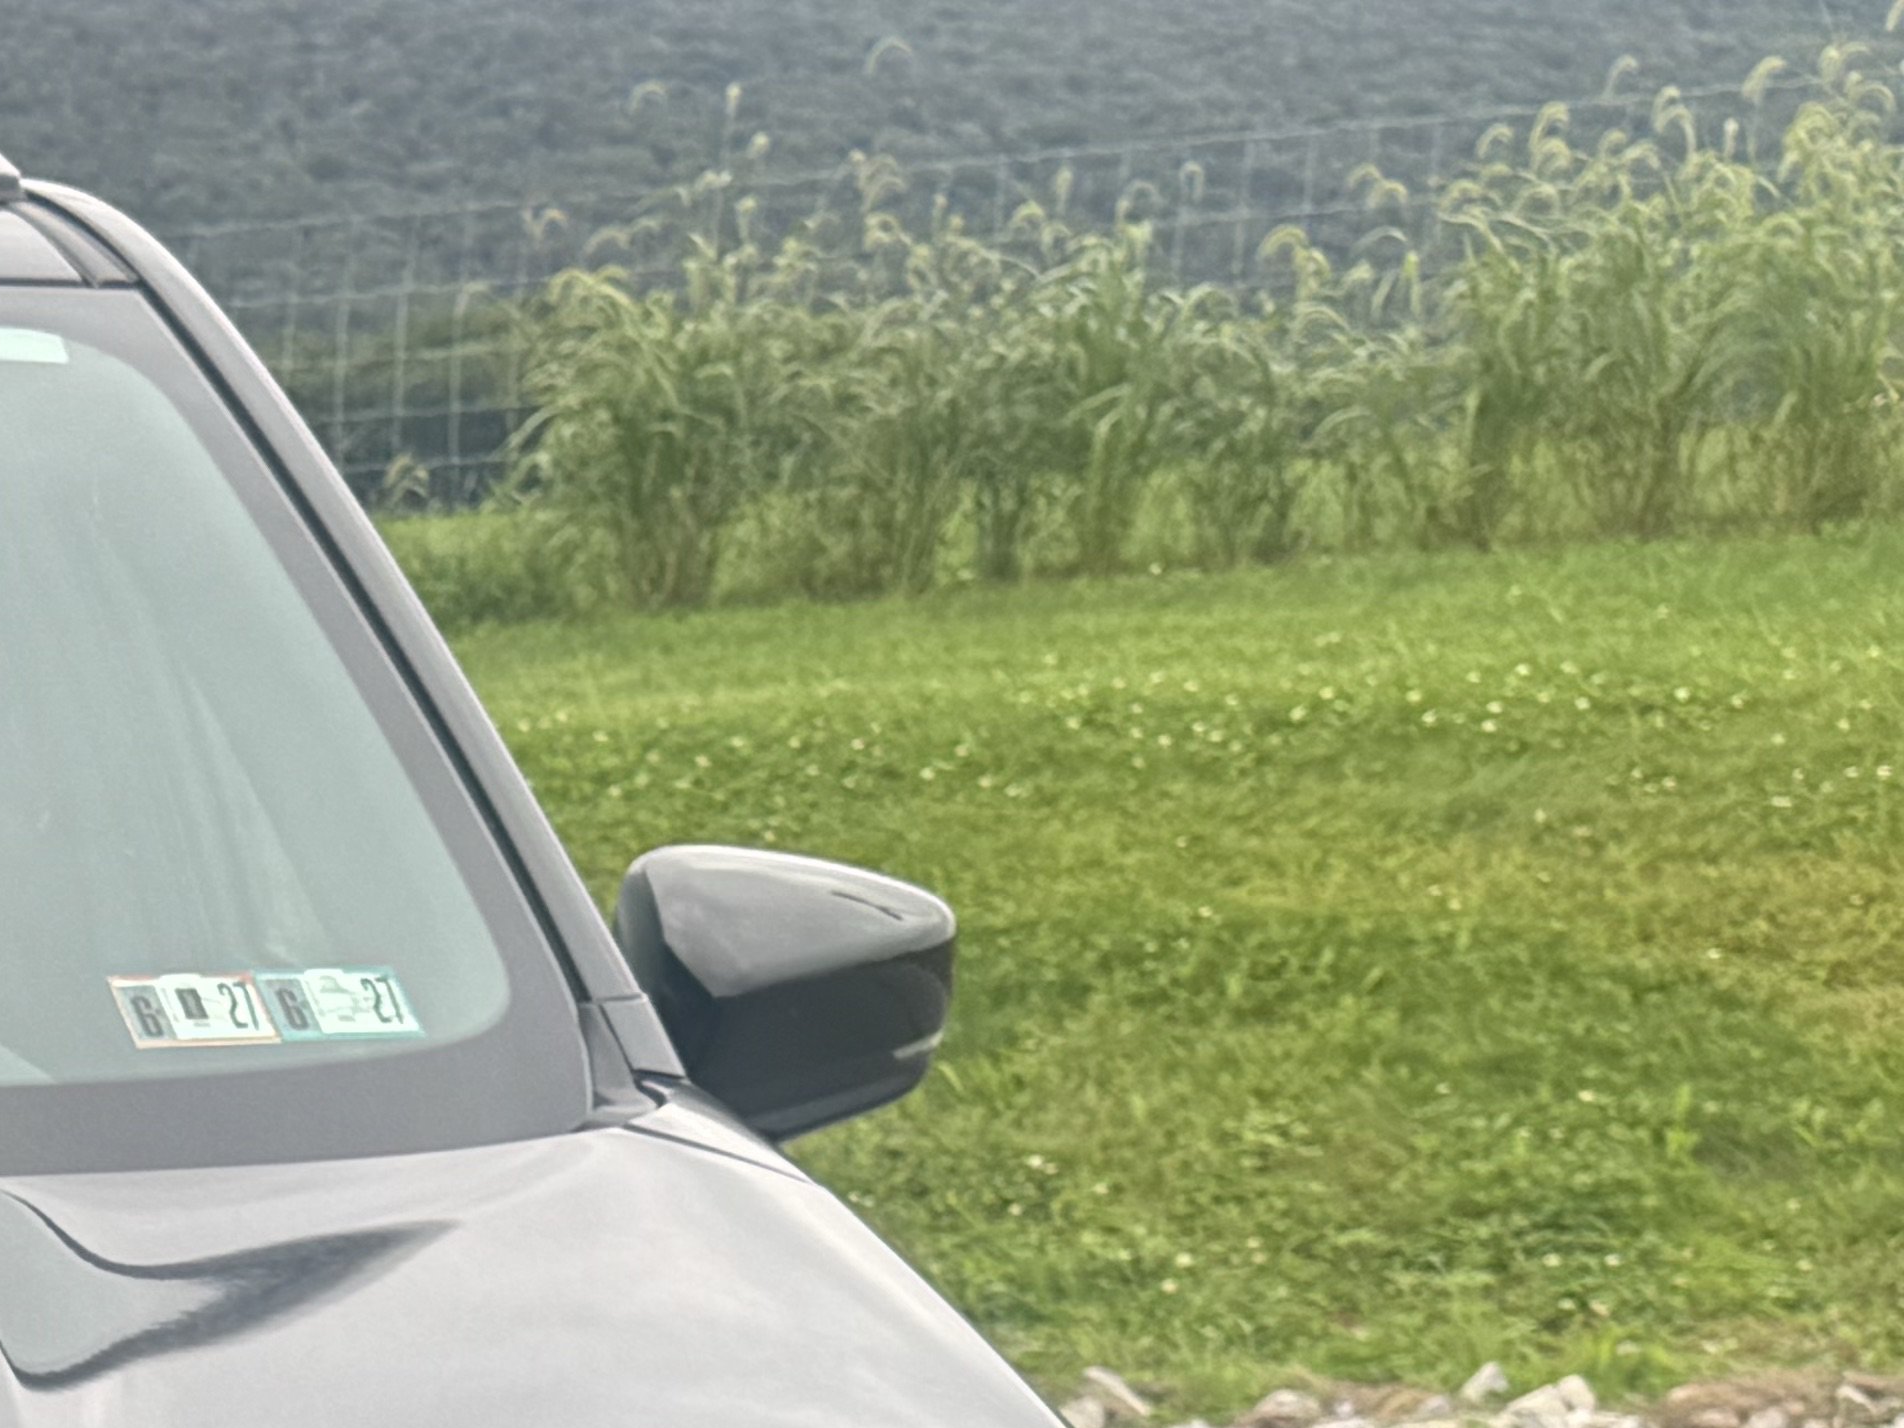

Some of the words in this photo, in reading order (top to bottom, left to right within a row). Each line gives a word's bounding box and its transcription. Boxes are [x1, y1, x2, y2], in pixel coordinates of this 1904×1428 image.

[130, 995, 163, 1037] 6
[218, 981, 259, 1030] 27
[275, 988, 309, 1031] 6
[361, 975, 404, 1024] 27
